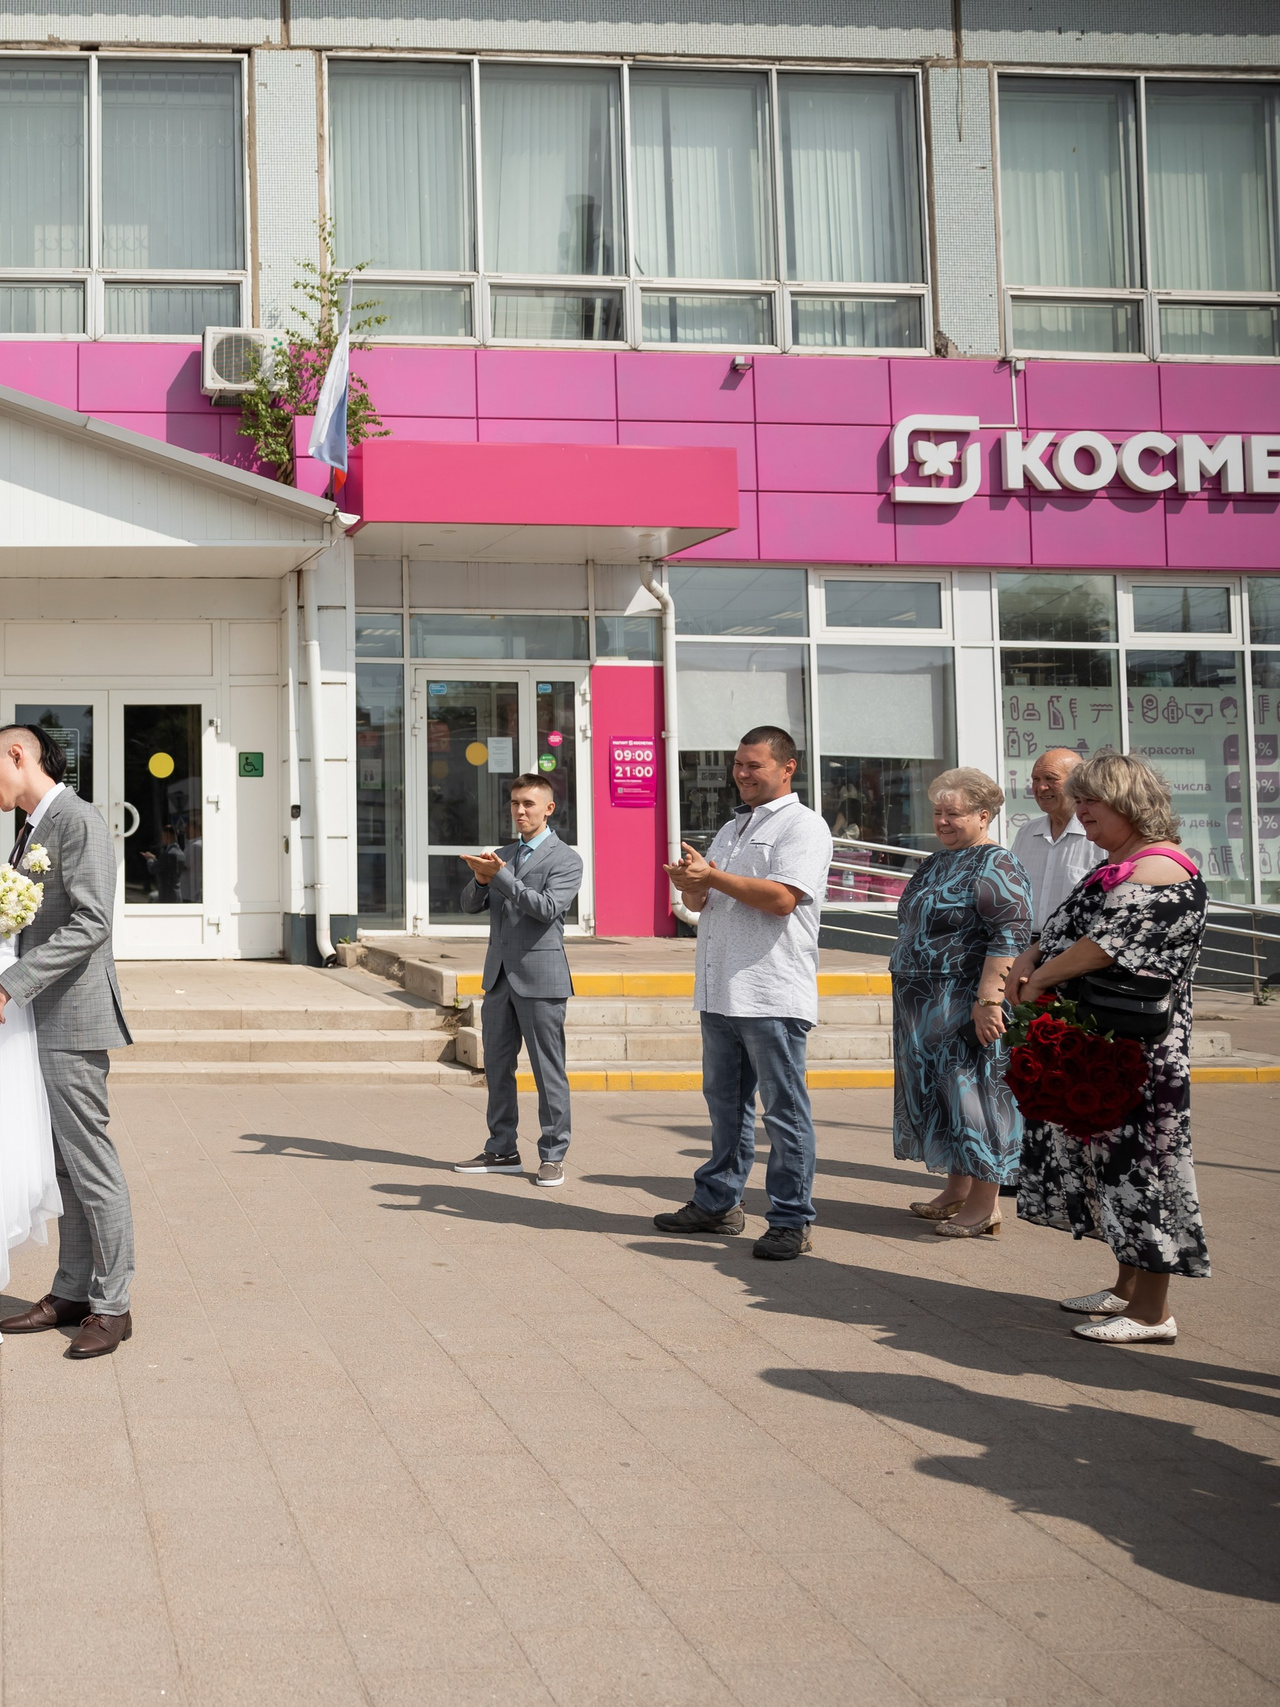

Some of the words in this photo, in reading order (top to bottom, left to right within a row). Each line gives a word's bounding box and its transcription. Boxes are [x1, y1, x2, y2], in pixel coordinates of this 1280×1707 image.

[1001, 430, 1280, 495] КОСМЕ
[614, 750, 652, 761] 09:00
[1140, 746, 1195, 757] красоты
[615, 766, 653, 777] 21:00
[1174, 782, 1212, 792] числа
[1190, 819, 1222, 829] день
